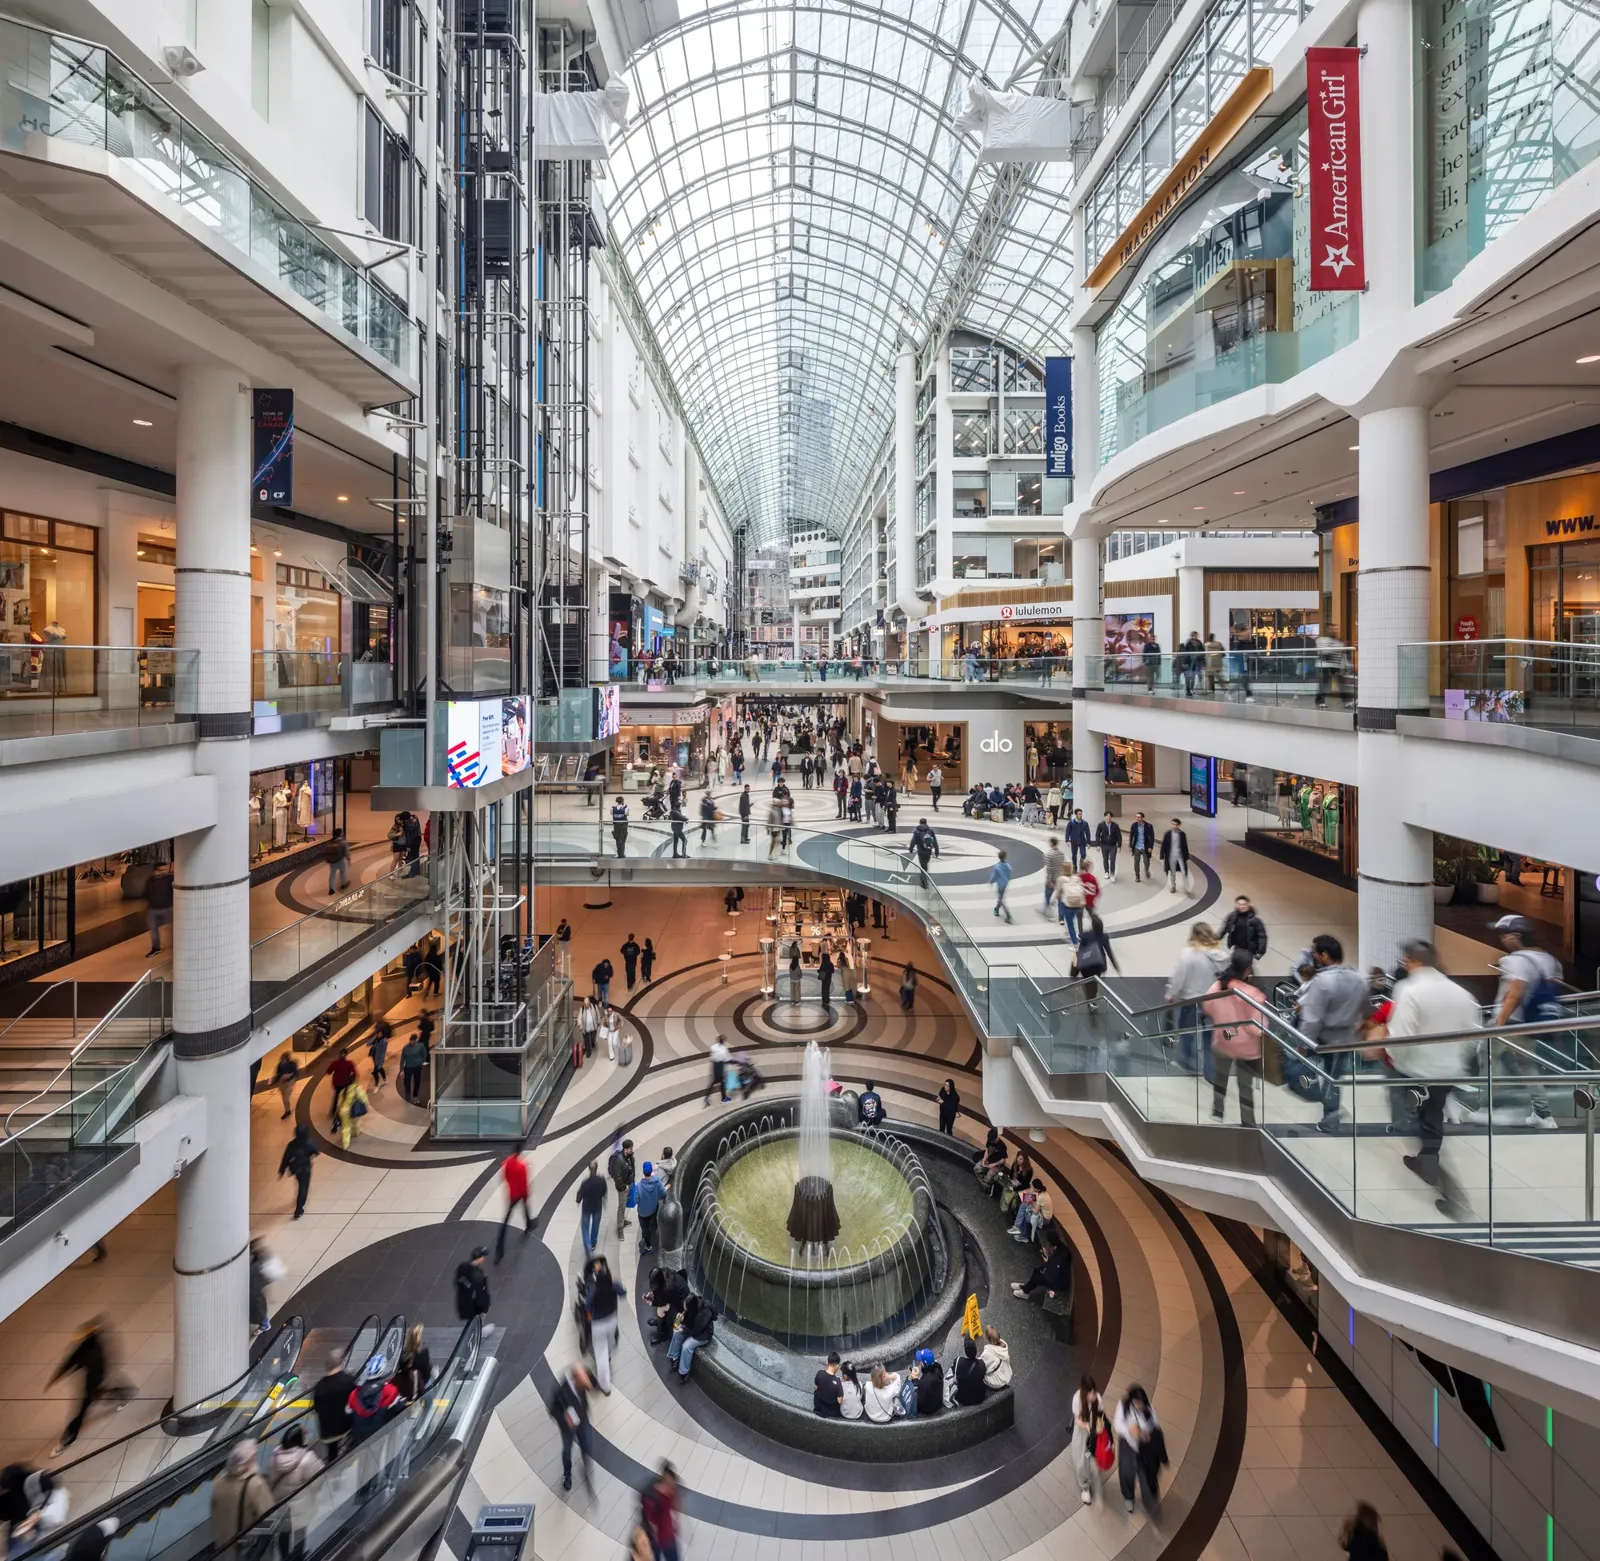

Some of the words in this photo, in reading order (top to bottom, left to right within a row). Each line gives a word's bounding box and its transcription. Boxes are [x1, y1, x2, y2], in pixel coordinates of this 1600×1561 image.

[1119, 147, 1210, 265] IMAGINATION
[1053, 396, 1066, 433] Books
[273, 491, 286, 499] CF
[1015, 605, 1062, 616] lululemon
[980, 730, 1013, 753] alo
